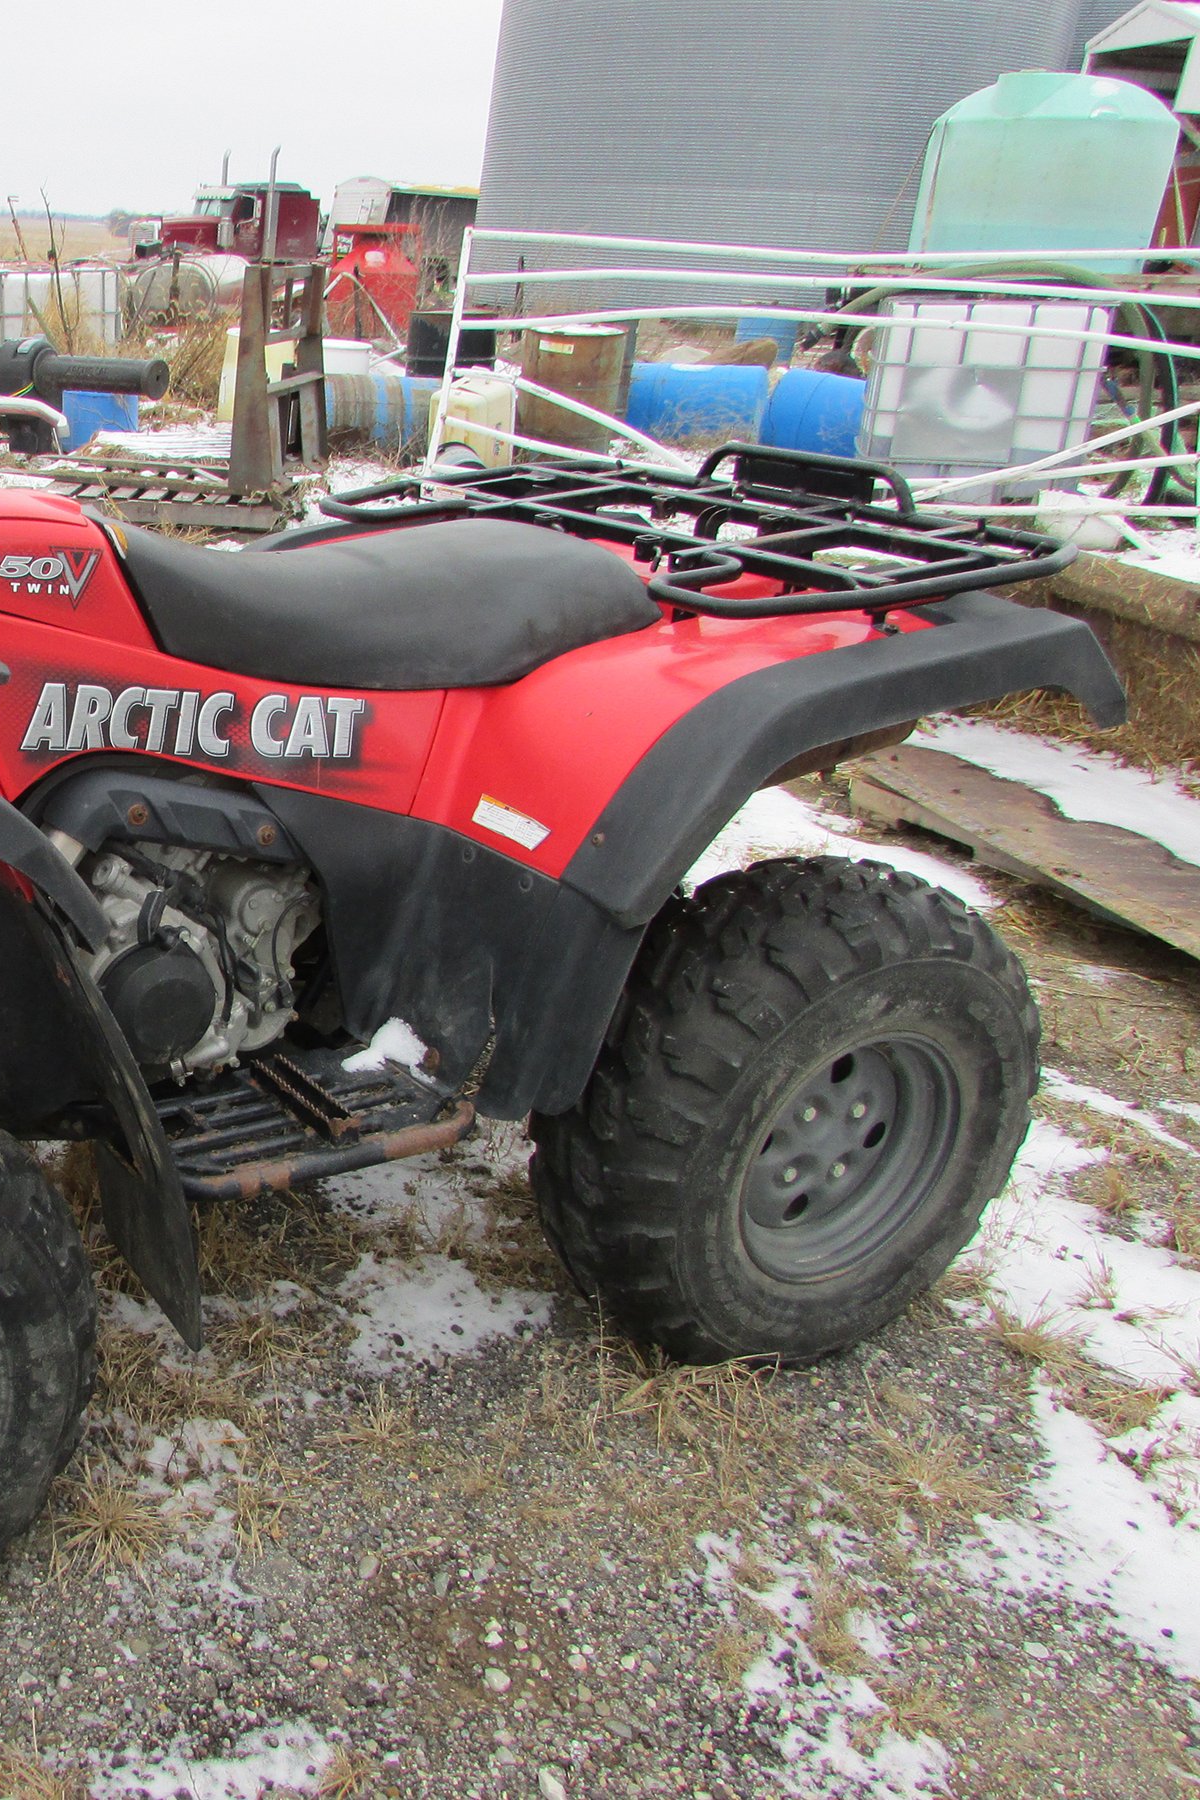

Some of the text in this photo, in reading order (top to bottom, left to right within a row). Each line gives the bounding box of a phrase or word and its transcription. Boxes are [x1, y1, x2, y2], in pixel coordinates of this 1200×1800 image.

[10, 582, 70, 595] TWIN
[19, 682, 366, 758] ARCTIC CAT
